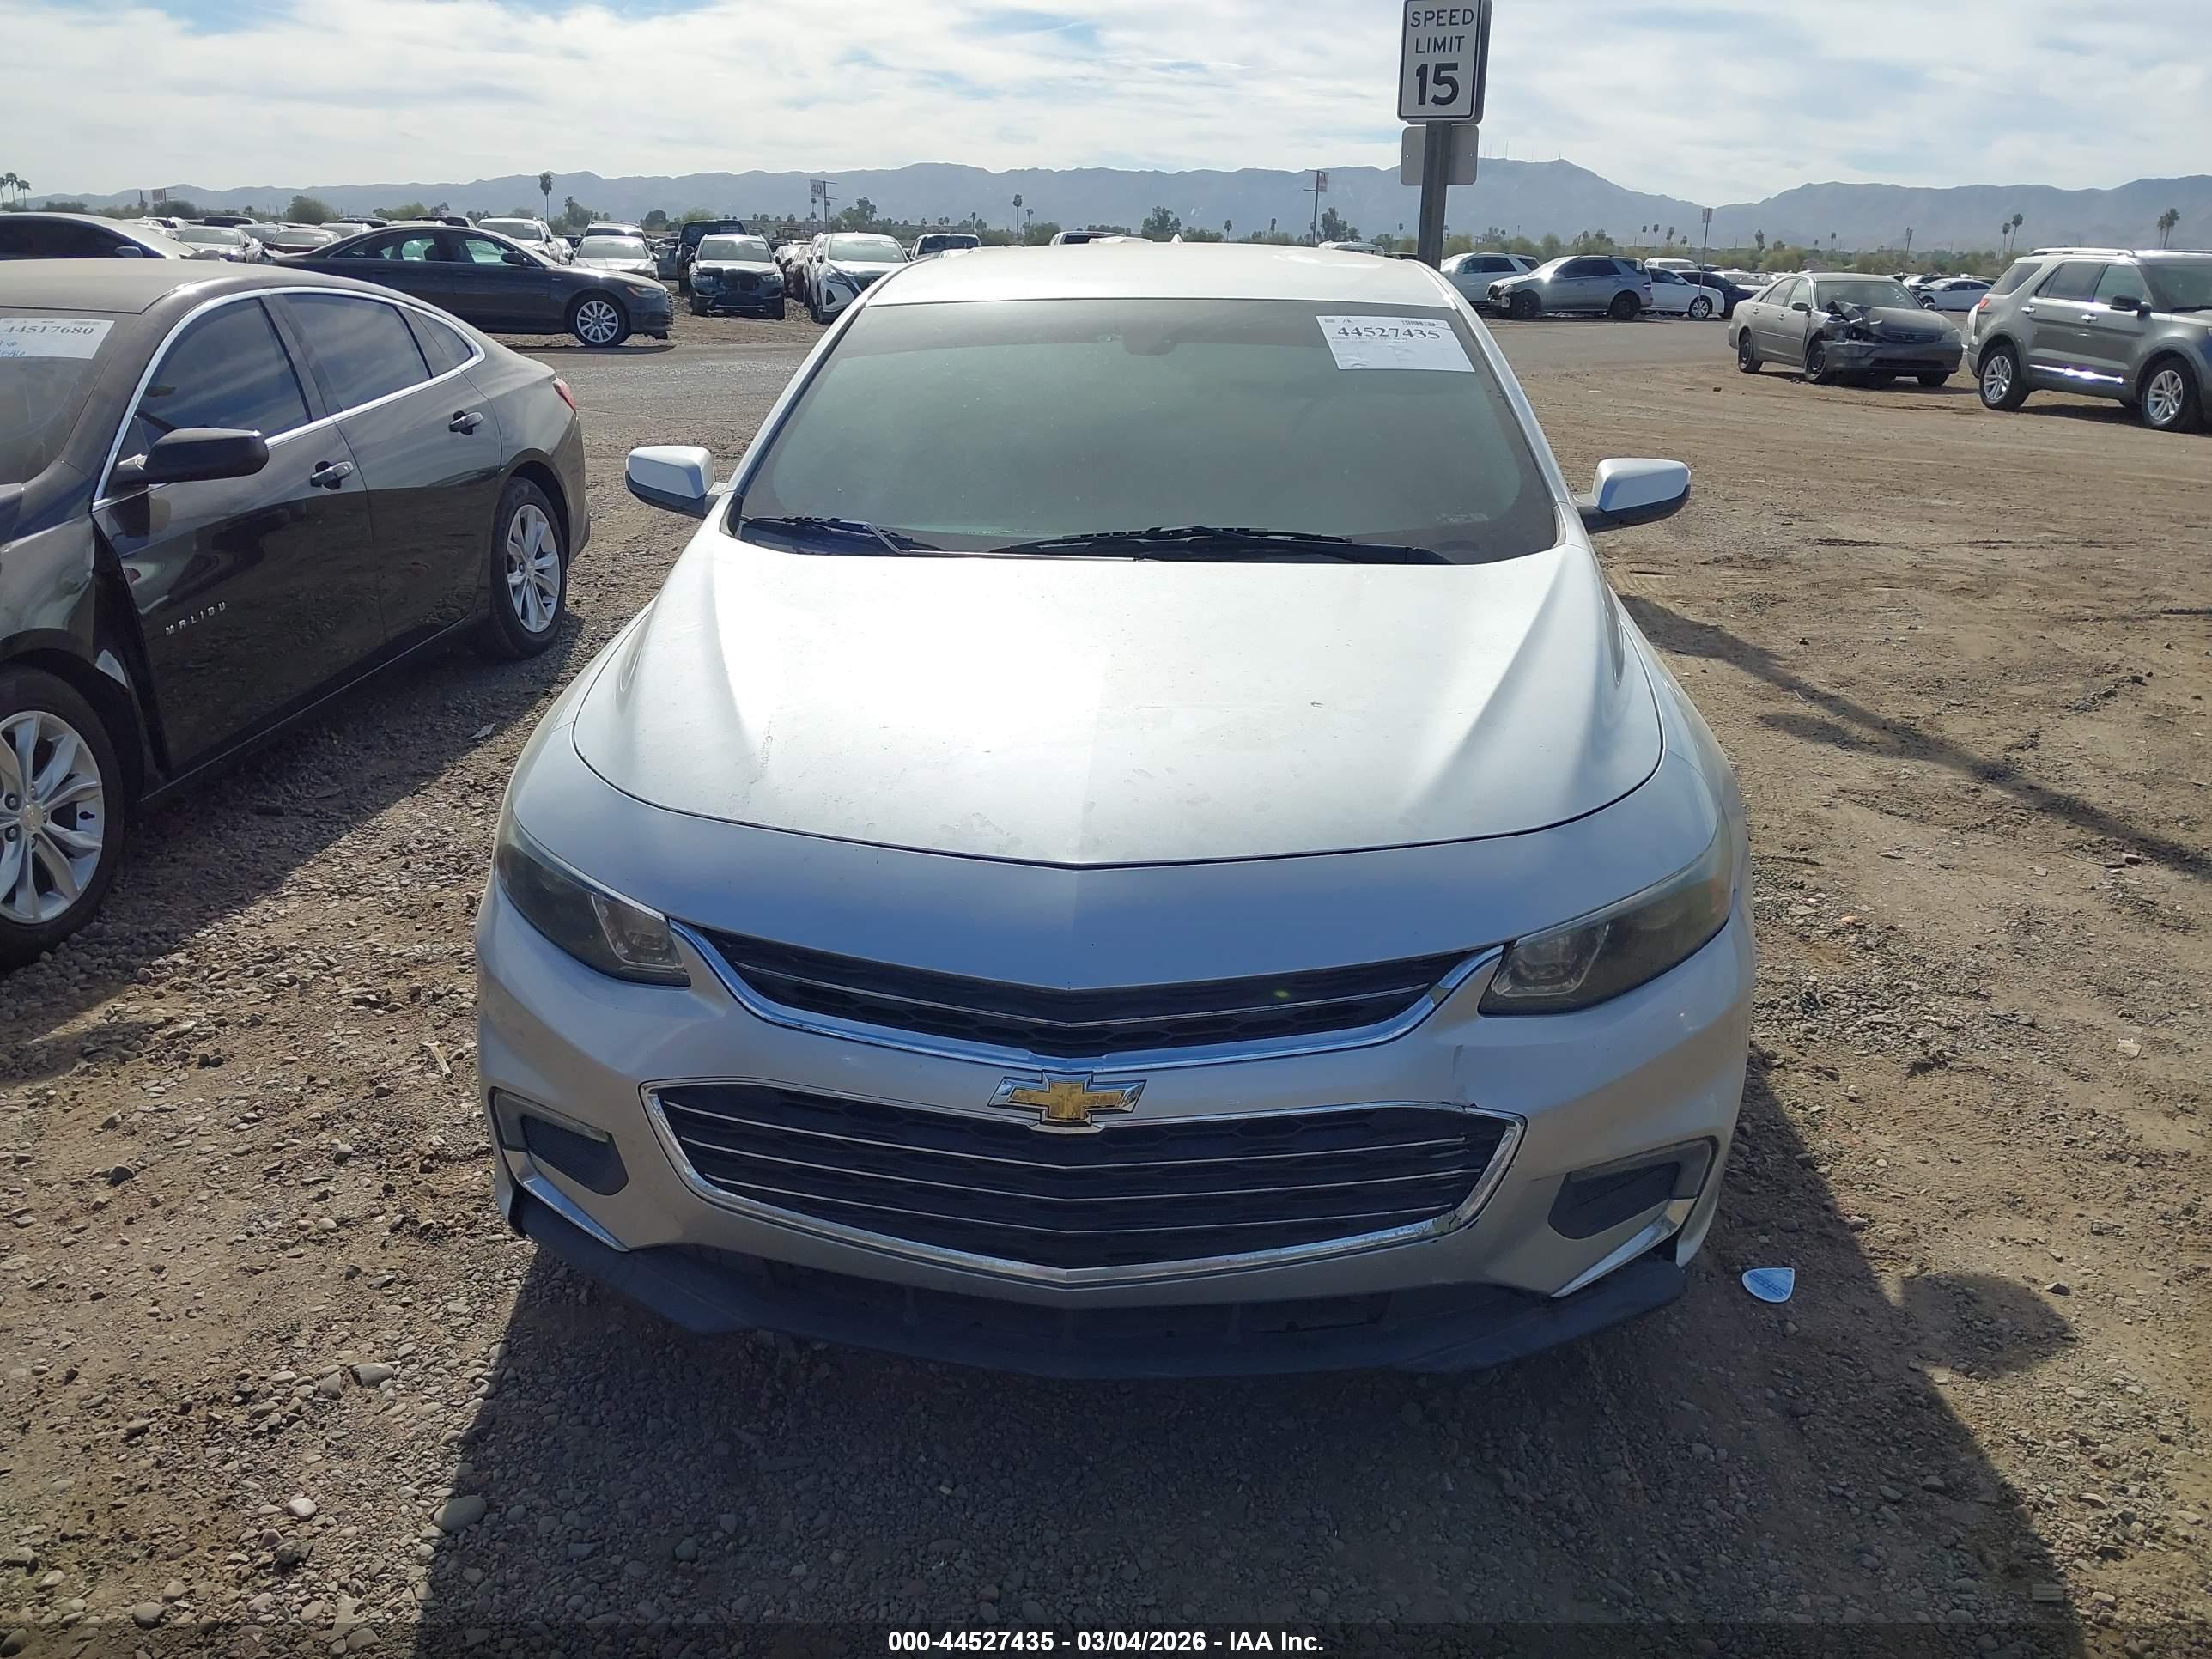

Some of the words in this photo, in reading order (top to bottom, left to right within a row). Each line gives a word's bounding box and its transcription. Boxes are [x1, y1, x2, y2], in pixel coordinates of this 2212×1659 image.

[1410, 9, 1474, 28] SPEED
[1415, 35, 1465, 54] LIMIT
[1415, 62, 1460, 106] 15
[3, 325, 94, 335] 44517680
[1337, 326, 1441, 339] 44527435
[165, 601, 226, 635] MALIBU
